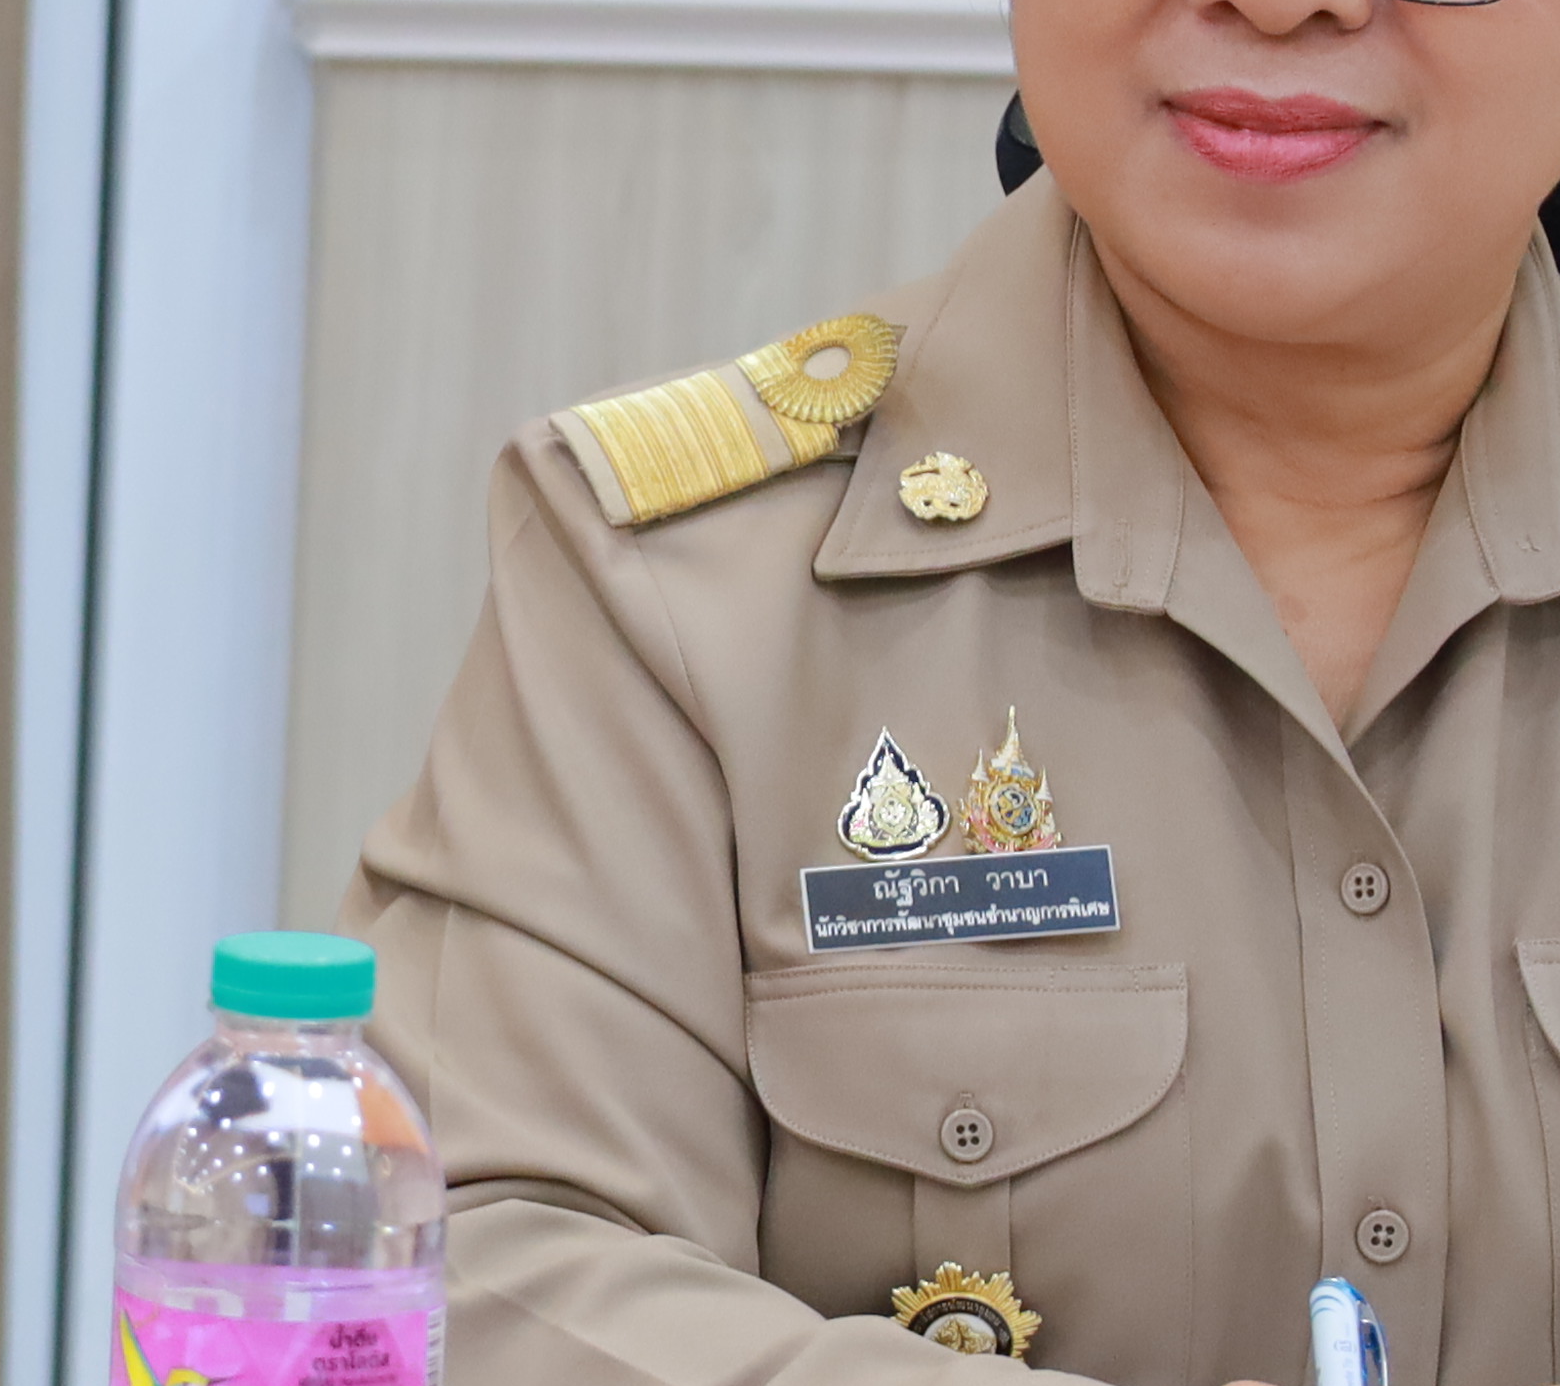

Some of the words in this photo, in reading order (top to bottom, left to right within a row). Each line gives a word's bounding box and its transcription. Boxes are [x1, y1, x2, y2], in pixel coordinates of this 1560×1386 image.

[873, 869, 960, 906] ณัฐวิกา
[986, 868, 1049, 892] วาบา
[814, 897, 1110, 938] นักวิชาการพัฒนาชุมชนชำนาญการพิเศษ
